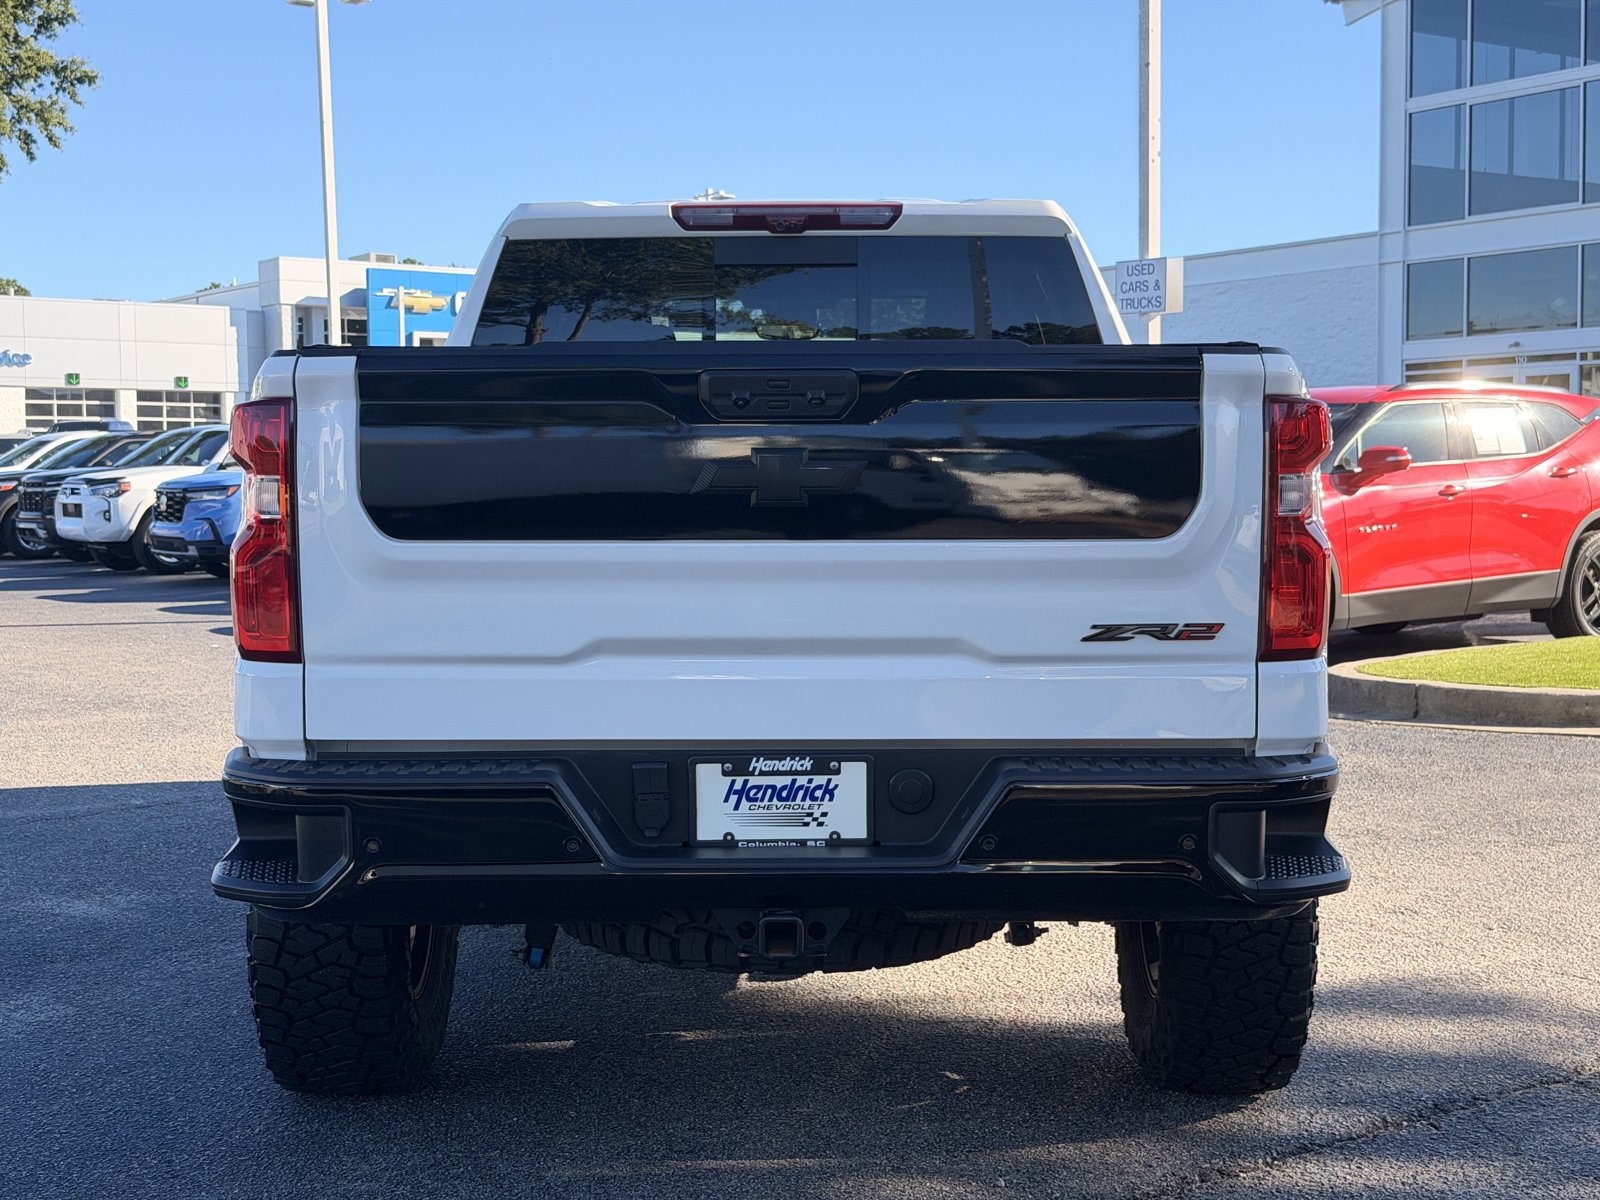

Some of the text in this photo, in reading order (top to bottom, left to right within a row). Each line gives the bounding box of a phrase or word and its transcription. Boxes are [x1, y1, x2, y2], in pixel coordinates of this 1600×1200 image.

[1126, 263, 1155, 277] USED
[1120, 279, 1160, 294] CARS &
[1120, 296, 1162, 310] TRUCKS
[1080, 623, 1225, 642] ZR2
[748, 757, 813, 775] Hendrick
[723, 778, 839, 811] Hendrick
